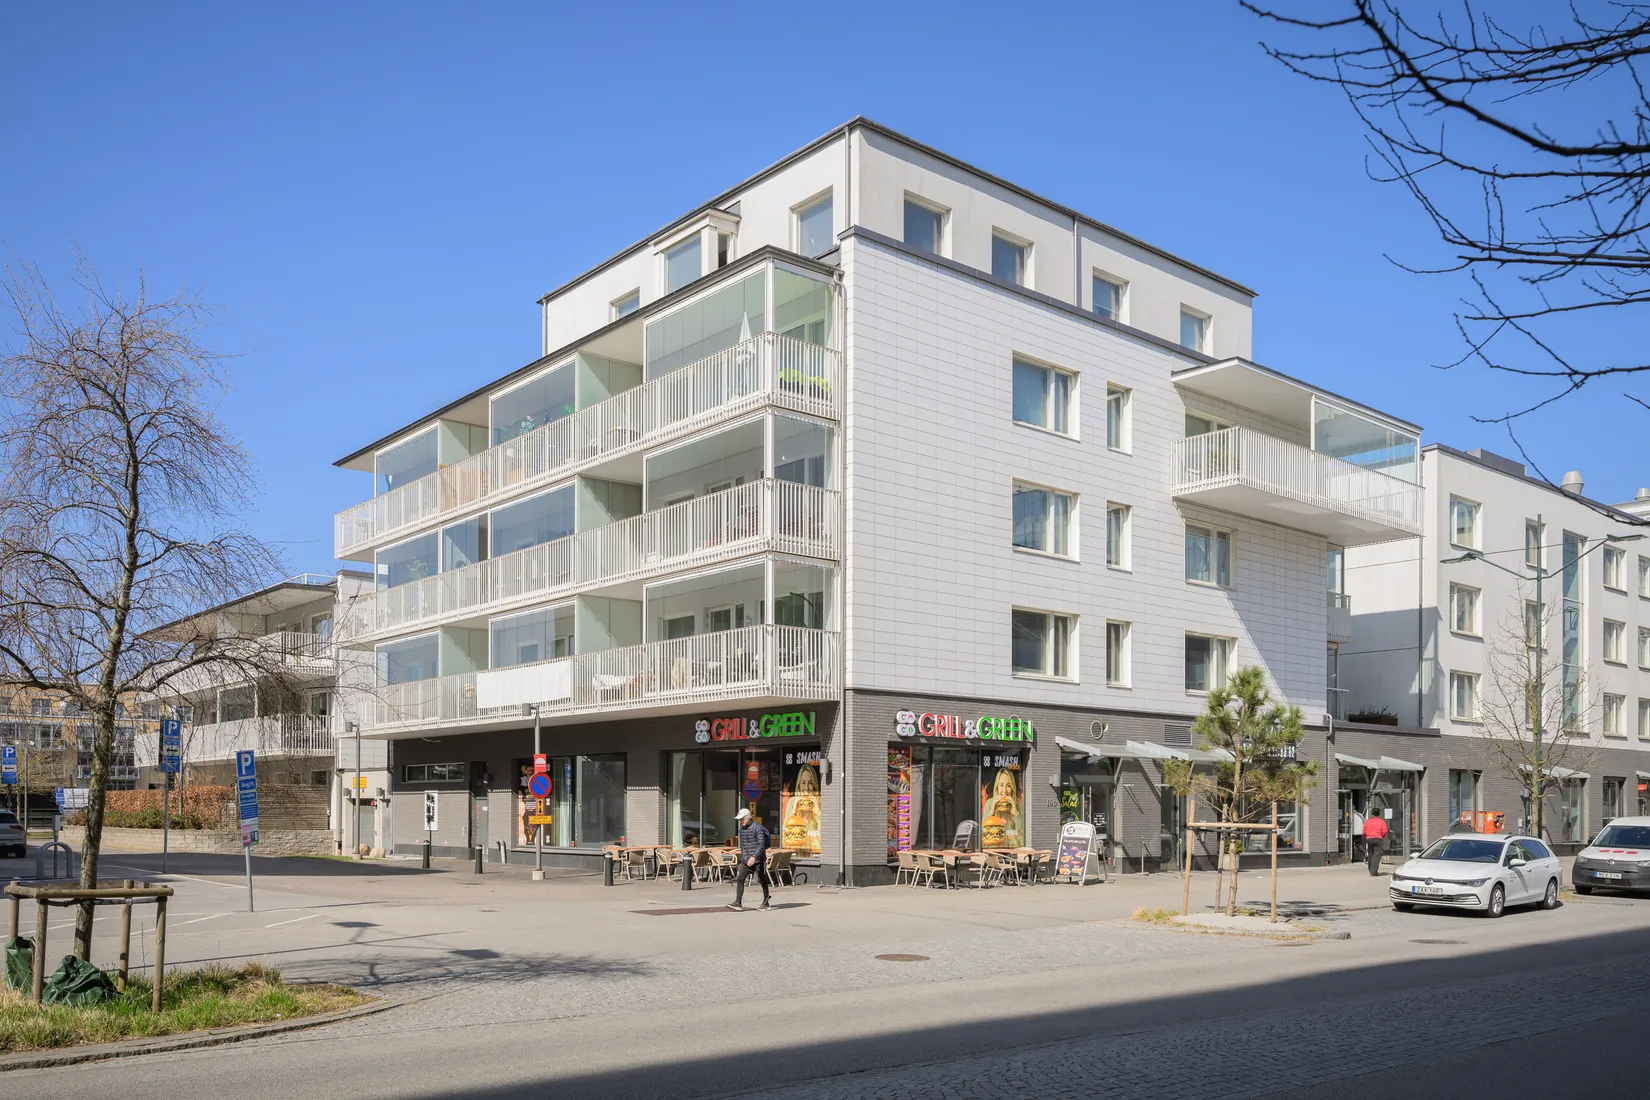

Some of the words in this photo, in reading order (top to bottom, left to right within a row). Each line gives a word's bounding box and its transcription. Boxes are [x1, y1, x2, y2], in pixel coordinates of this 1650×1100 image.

[168, 720, 178, 735] P
[5, 747, 14, 757] P
[796, 751, 820, 765] SMASH
[241, 753, 252, 775] P
[994, 755, 1019, 767] SMASH
